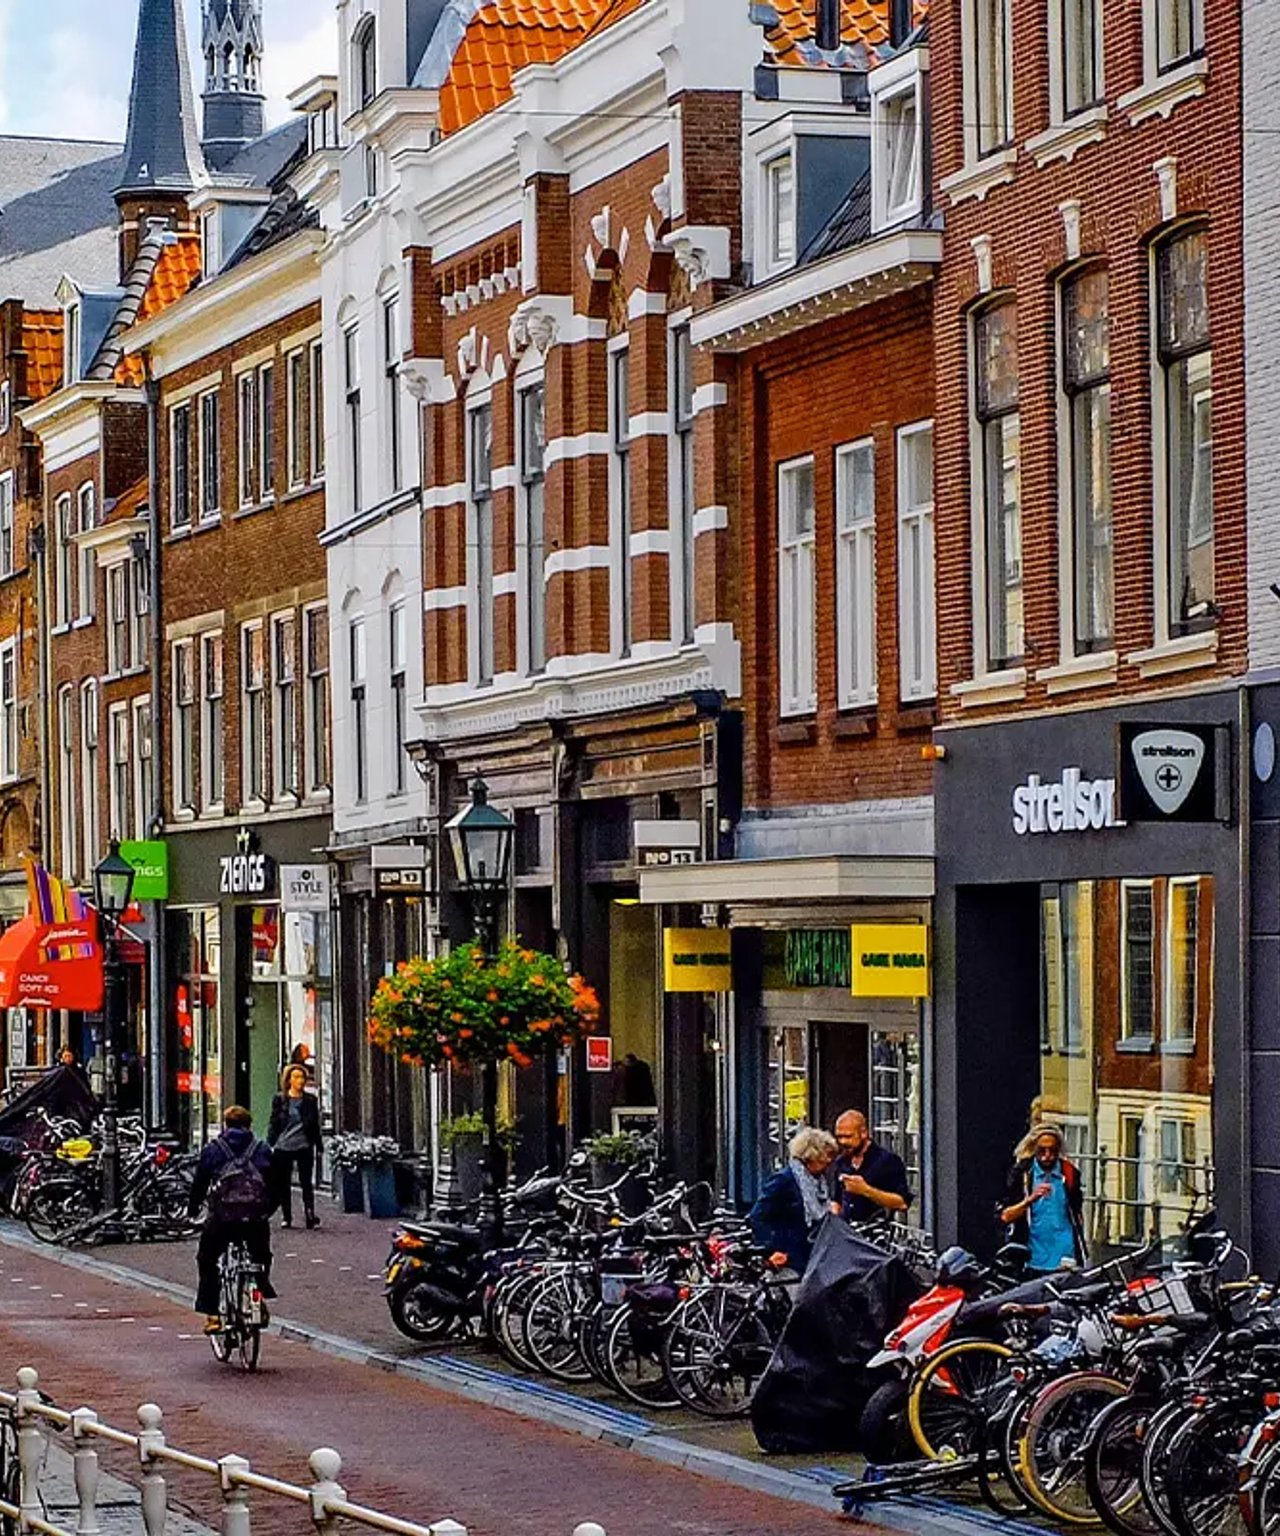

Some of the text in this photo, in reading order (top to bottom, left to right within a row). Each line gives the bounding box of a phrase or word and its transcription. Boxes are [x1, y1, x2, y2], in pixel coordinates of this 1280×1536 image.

[1141, 744, 1196, 758] strellson
[220, 854, 265, 893] ZIENGS
[290, 881, 323, 894] STYLE
